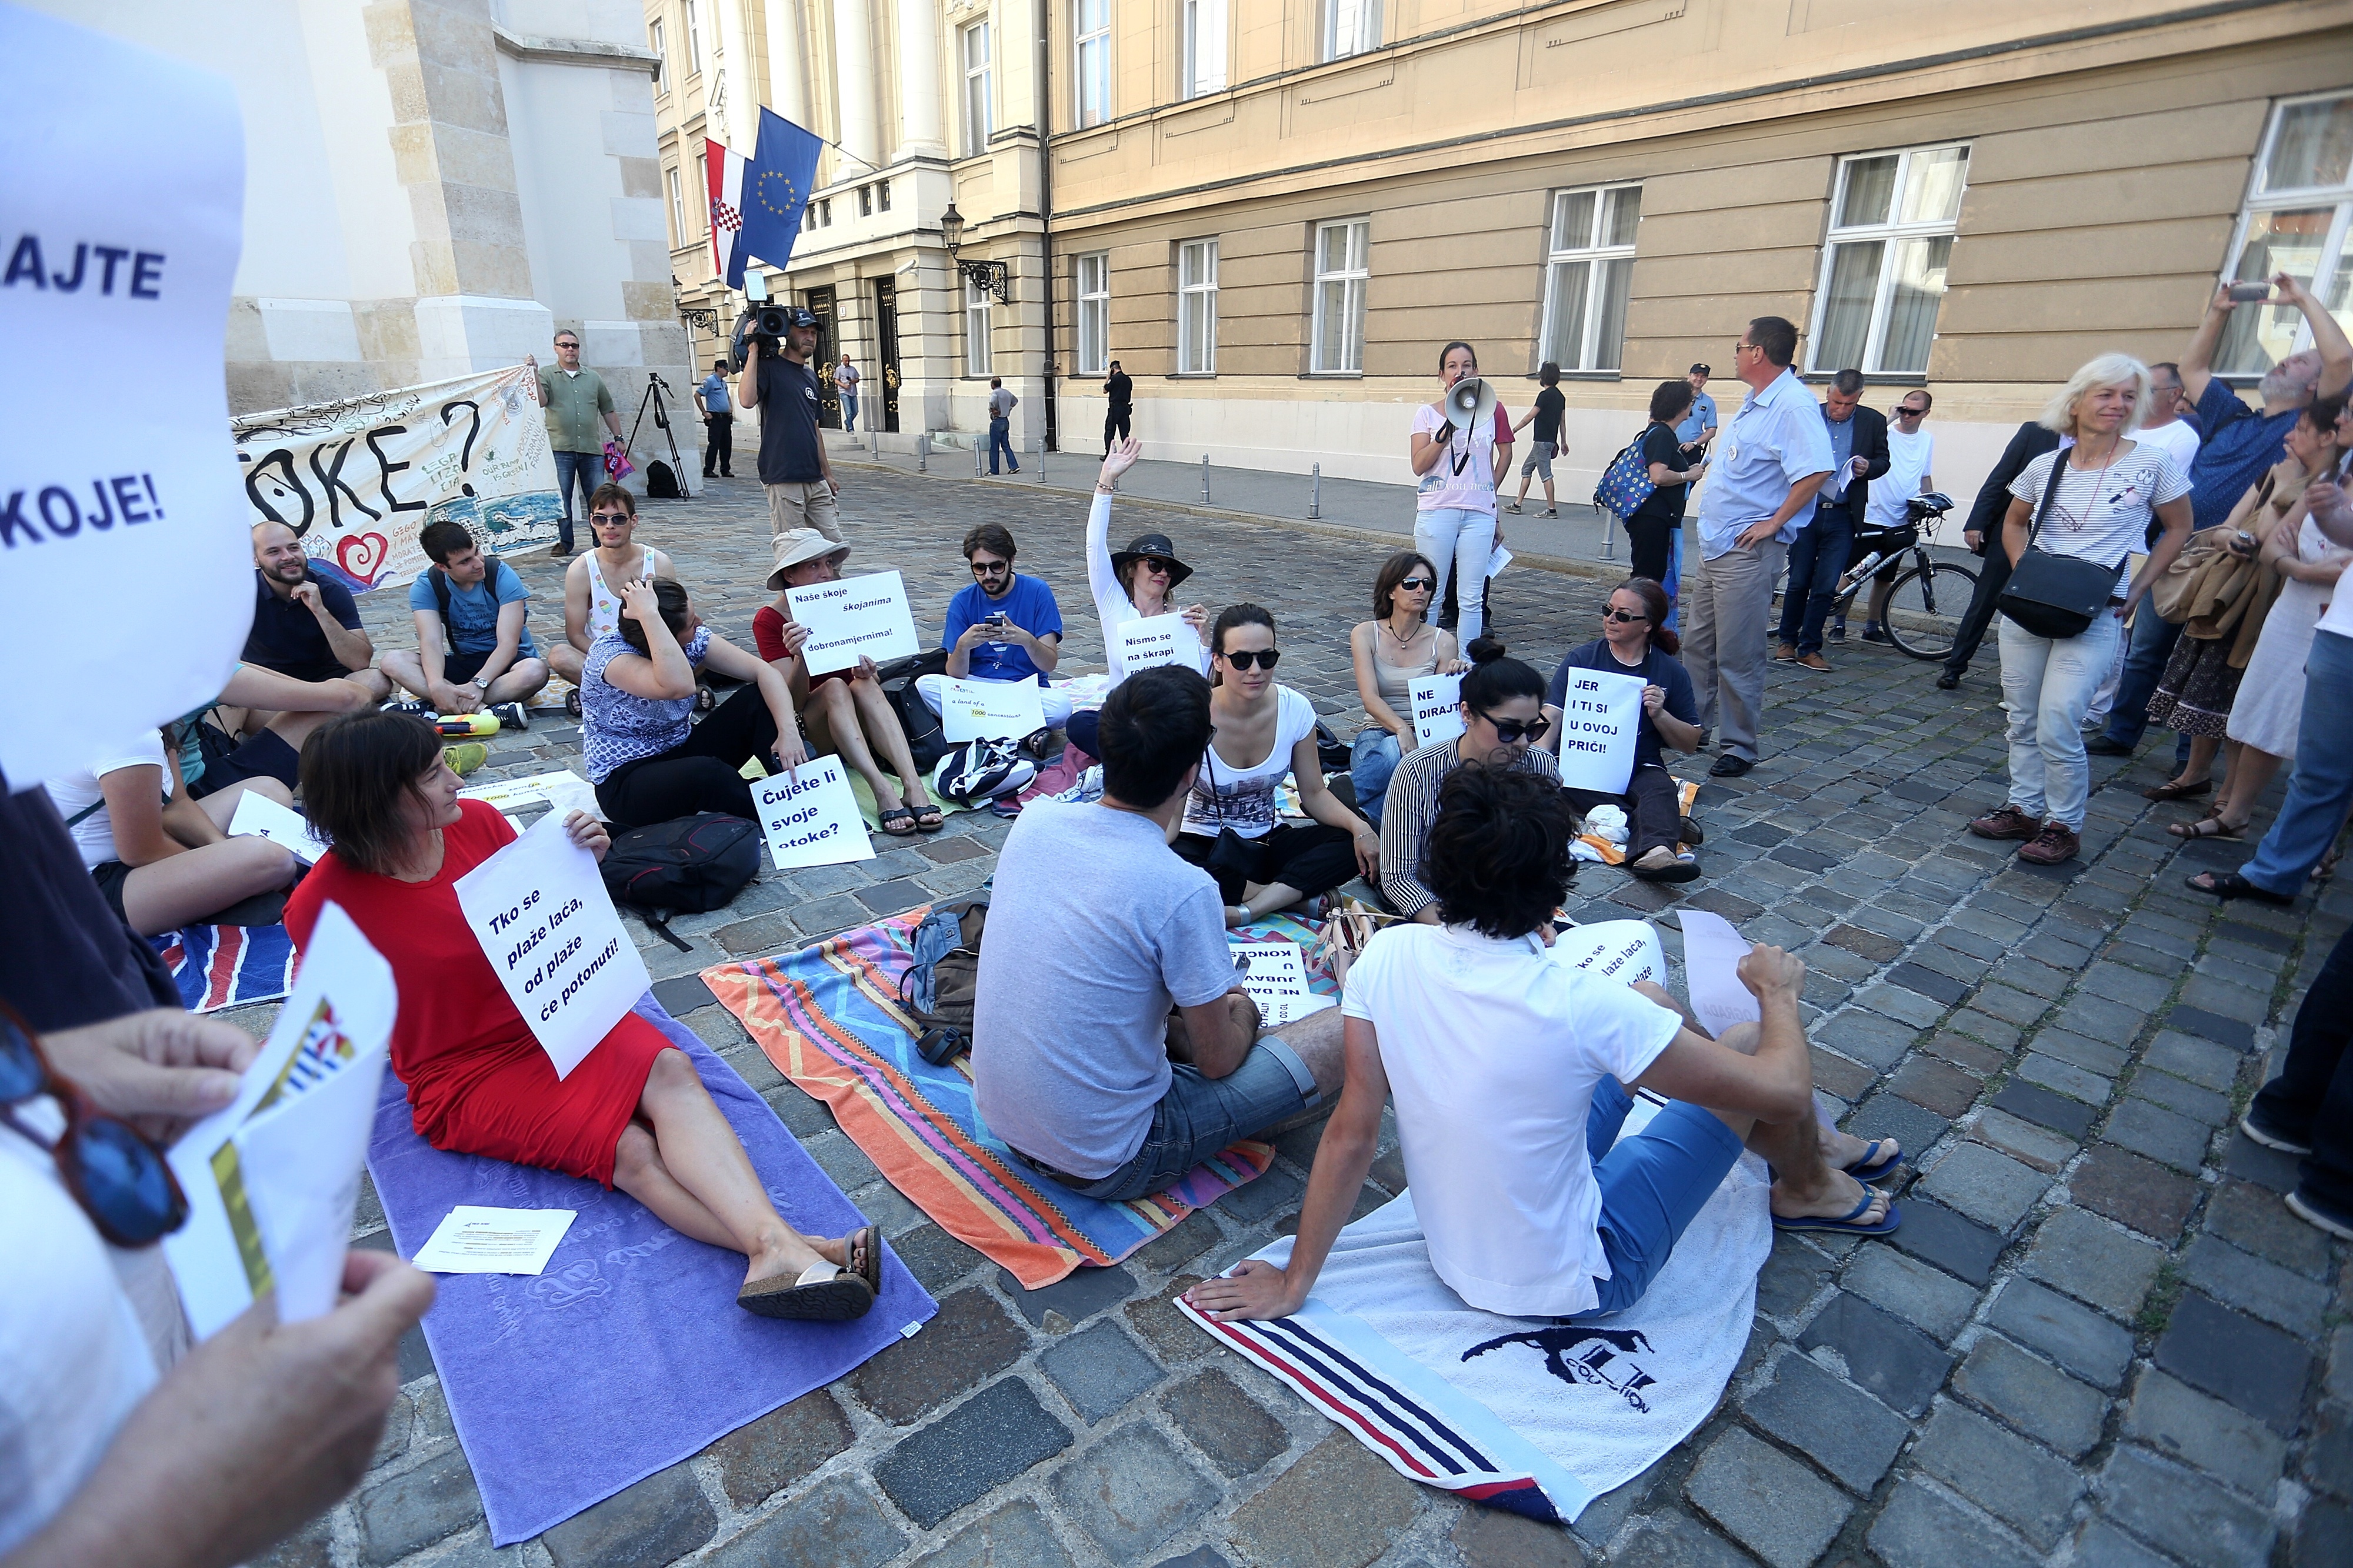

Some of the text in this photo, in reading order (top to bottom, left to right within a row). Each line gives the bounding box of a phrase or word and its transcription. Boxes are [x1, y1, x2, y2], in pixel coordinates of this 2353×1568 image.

[2, 233, 166, 301] AJTE
[525, 425, 541, 460] ZORANU
[238, 401, 480, 539] OKE?
[482, 463, 499, 476] OUR
[492, 473, 502, 482] IS
[1427, 481, 1438, 492] all
[392, 521, 416, 537] GEGO
[400, 531, 419, 546] MAX
[392, 544, 423, 561] MORATE
[795, 588, 848, 603] Naše škoje
[842, 596, 891, 612] škojanima
[806, 627, 814, 635] &
[808, 628, 893, 652] dobronamjernima!
[1125, 636, 1156, 646] Nismo
[1142, 647, 1174, 659] škrapi
[1574, 679, 1599, 692] JER
[1417, 689, 1434, 701] NE
[1572, 700, 1608, 713] I TI SI
[1422, 728, 1431, 738] U
[1570, 720, 1618, 736] U OVOJ
[1568, 740, 1607, 753] PRIČI!
[508, 782, 541, 792] zemlja
[762, 769, 836, 805] Čujete li
[771, 807, 818, 830] svoje
[778, 823, 838, 849] otoke?
[489, 889, 541, 935] Tko se
[507, 898, 583, 970] plaže laća,
[1574, 943, 1606, 970] ko se
[1601, 938, 1648, 977] laže laća,
[525, 936, 582, 994] od plaže
[541, 938, 619, 1022] će potonuti!
